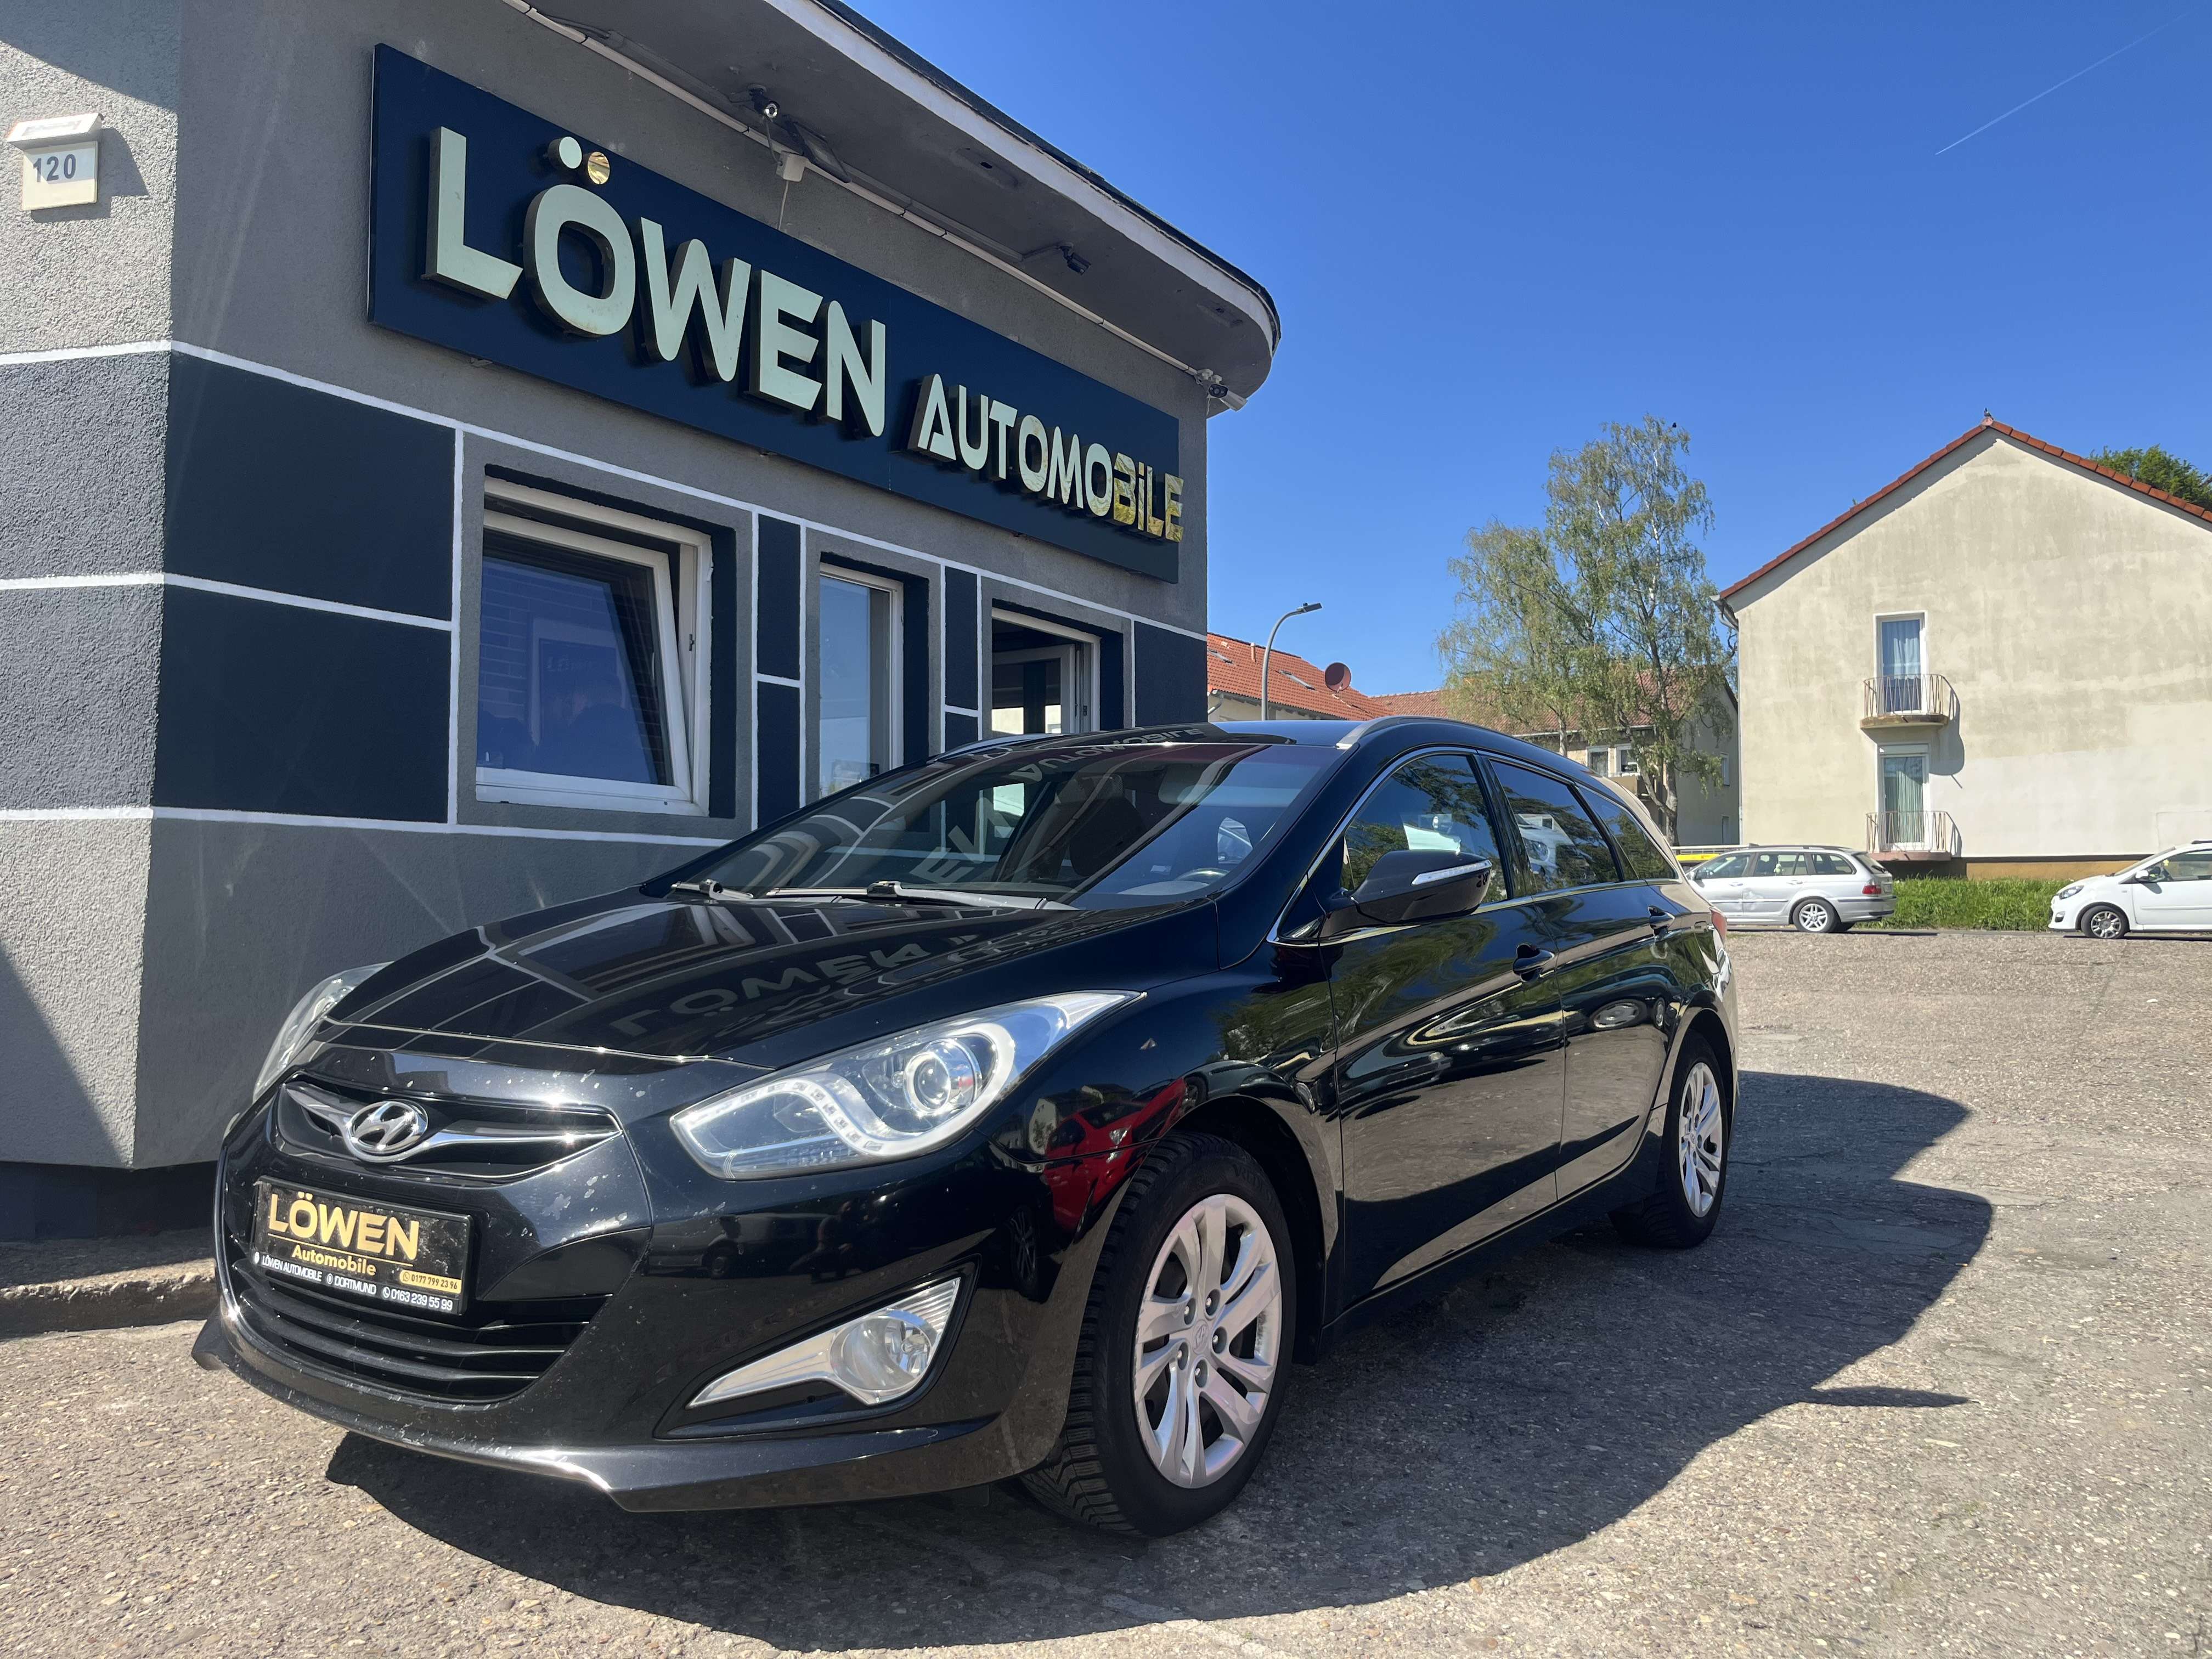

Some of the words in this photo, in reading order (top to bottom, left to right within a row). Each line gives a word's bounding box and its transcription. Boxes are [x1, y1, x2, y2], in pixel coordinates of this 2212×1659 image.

[33, 154, 76, 183] 120
[433, 126, 886, 437] LÖWEN
[269, 1192, 419, 1260] LÖWEN
[292, 1245, 376, 1276] Automobile
[283, 1263, 323, 1282] AUTOMOBILE
[335, 1276, 377, 1295] DORTMUND
[391, 1289, 410, 1302] 0163
[411, 1293, 427, 1306] 239
[428, 1296, 440, 1308] 55
[441, 1299, 453, 1311] 99
[411, 1274, 426, 1284] 0177
[428, 1277, 439, 1286] 799
[441, 1279, 448, 1288] 23
[450, 1281, 458, 1290] 96
